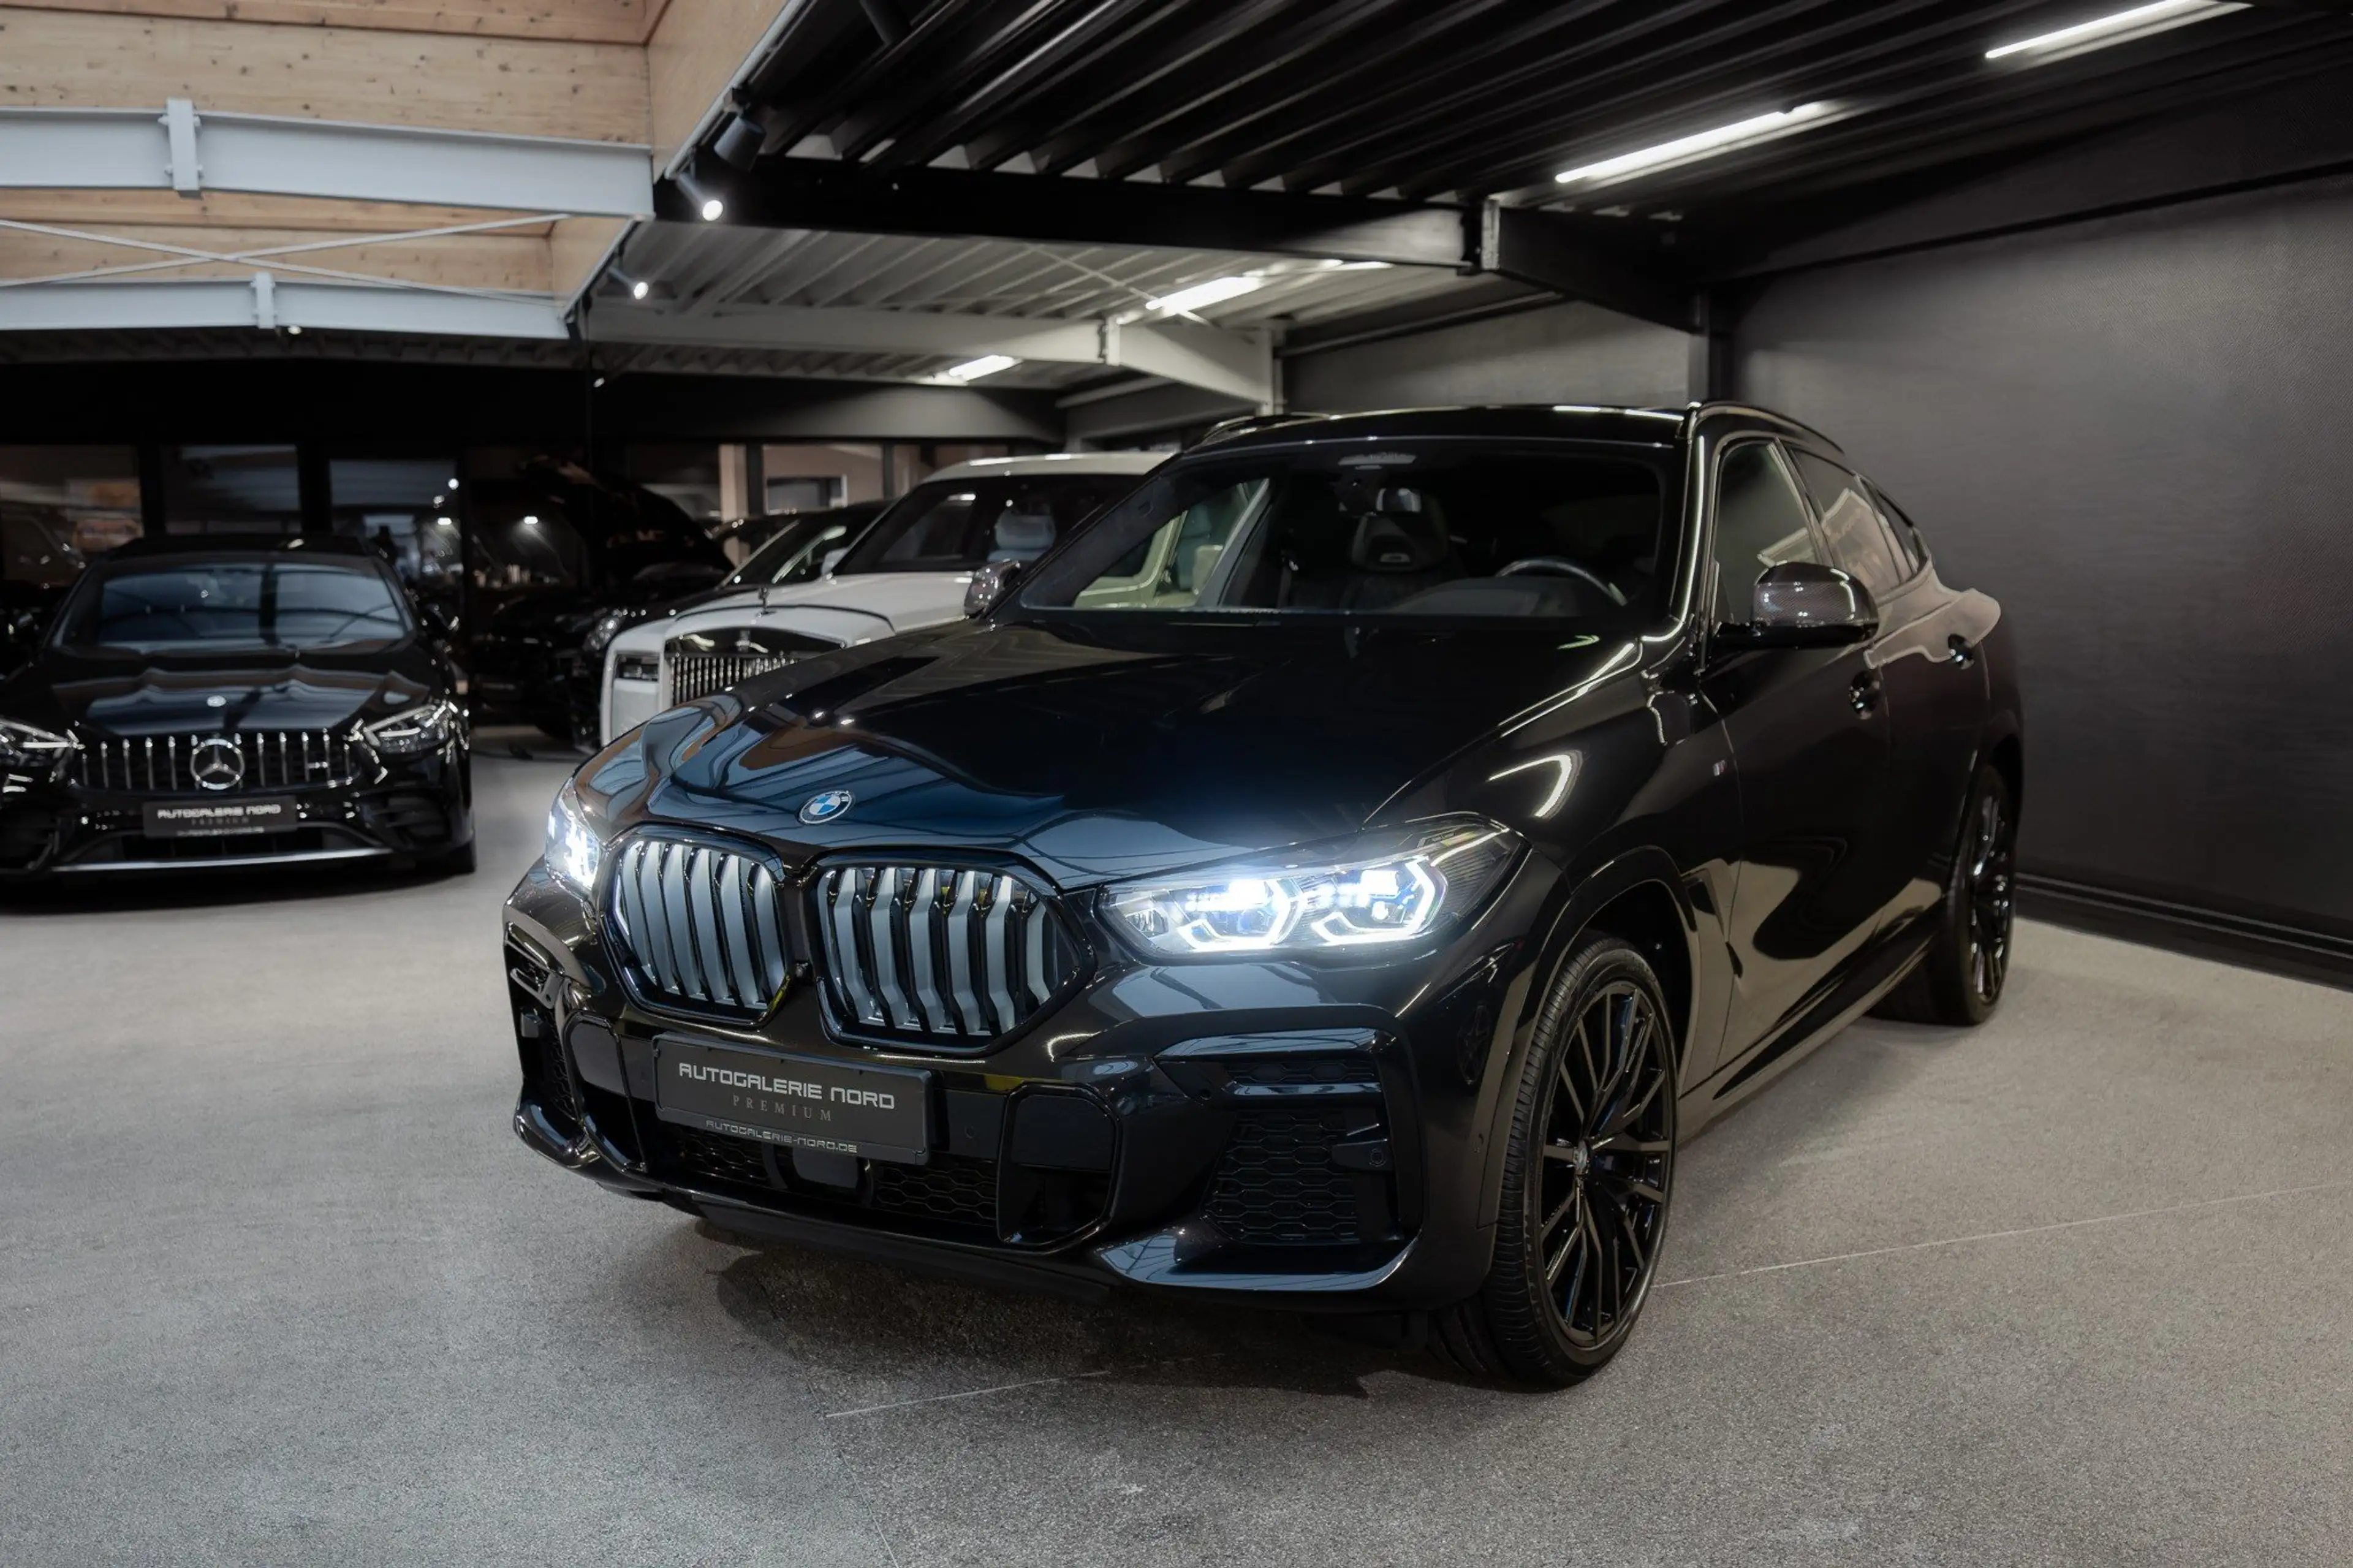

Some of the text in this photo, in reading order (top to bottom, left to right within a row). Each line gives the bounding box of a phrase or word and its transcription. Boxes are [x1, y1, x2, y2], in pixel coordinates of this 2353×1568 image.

[679, 1062, 895, 1110] AUTOGALERIE NORD
[733, 1094, 832, 1121] PREMIUM
[706, 1119, 857, 1153] AUTOGALERIE-NORD.DE
